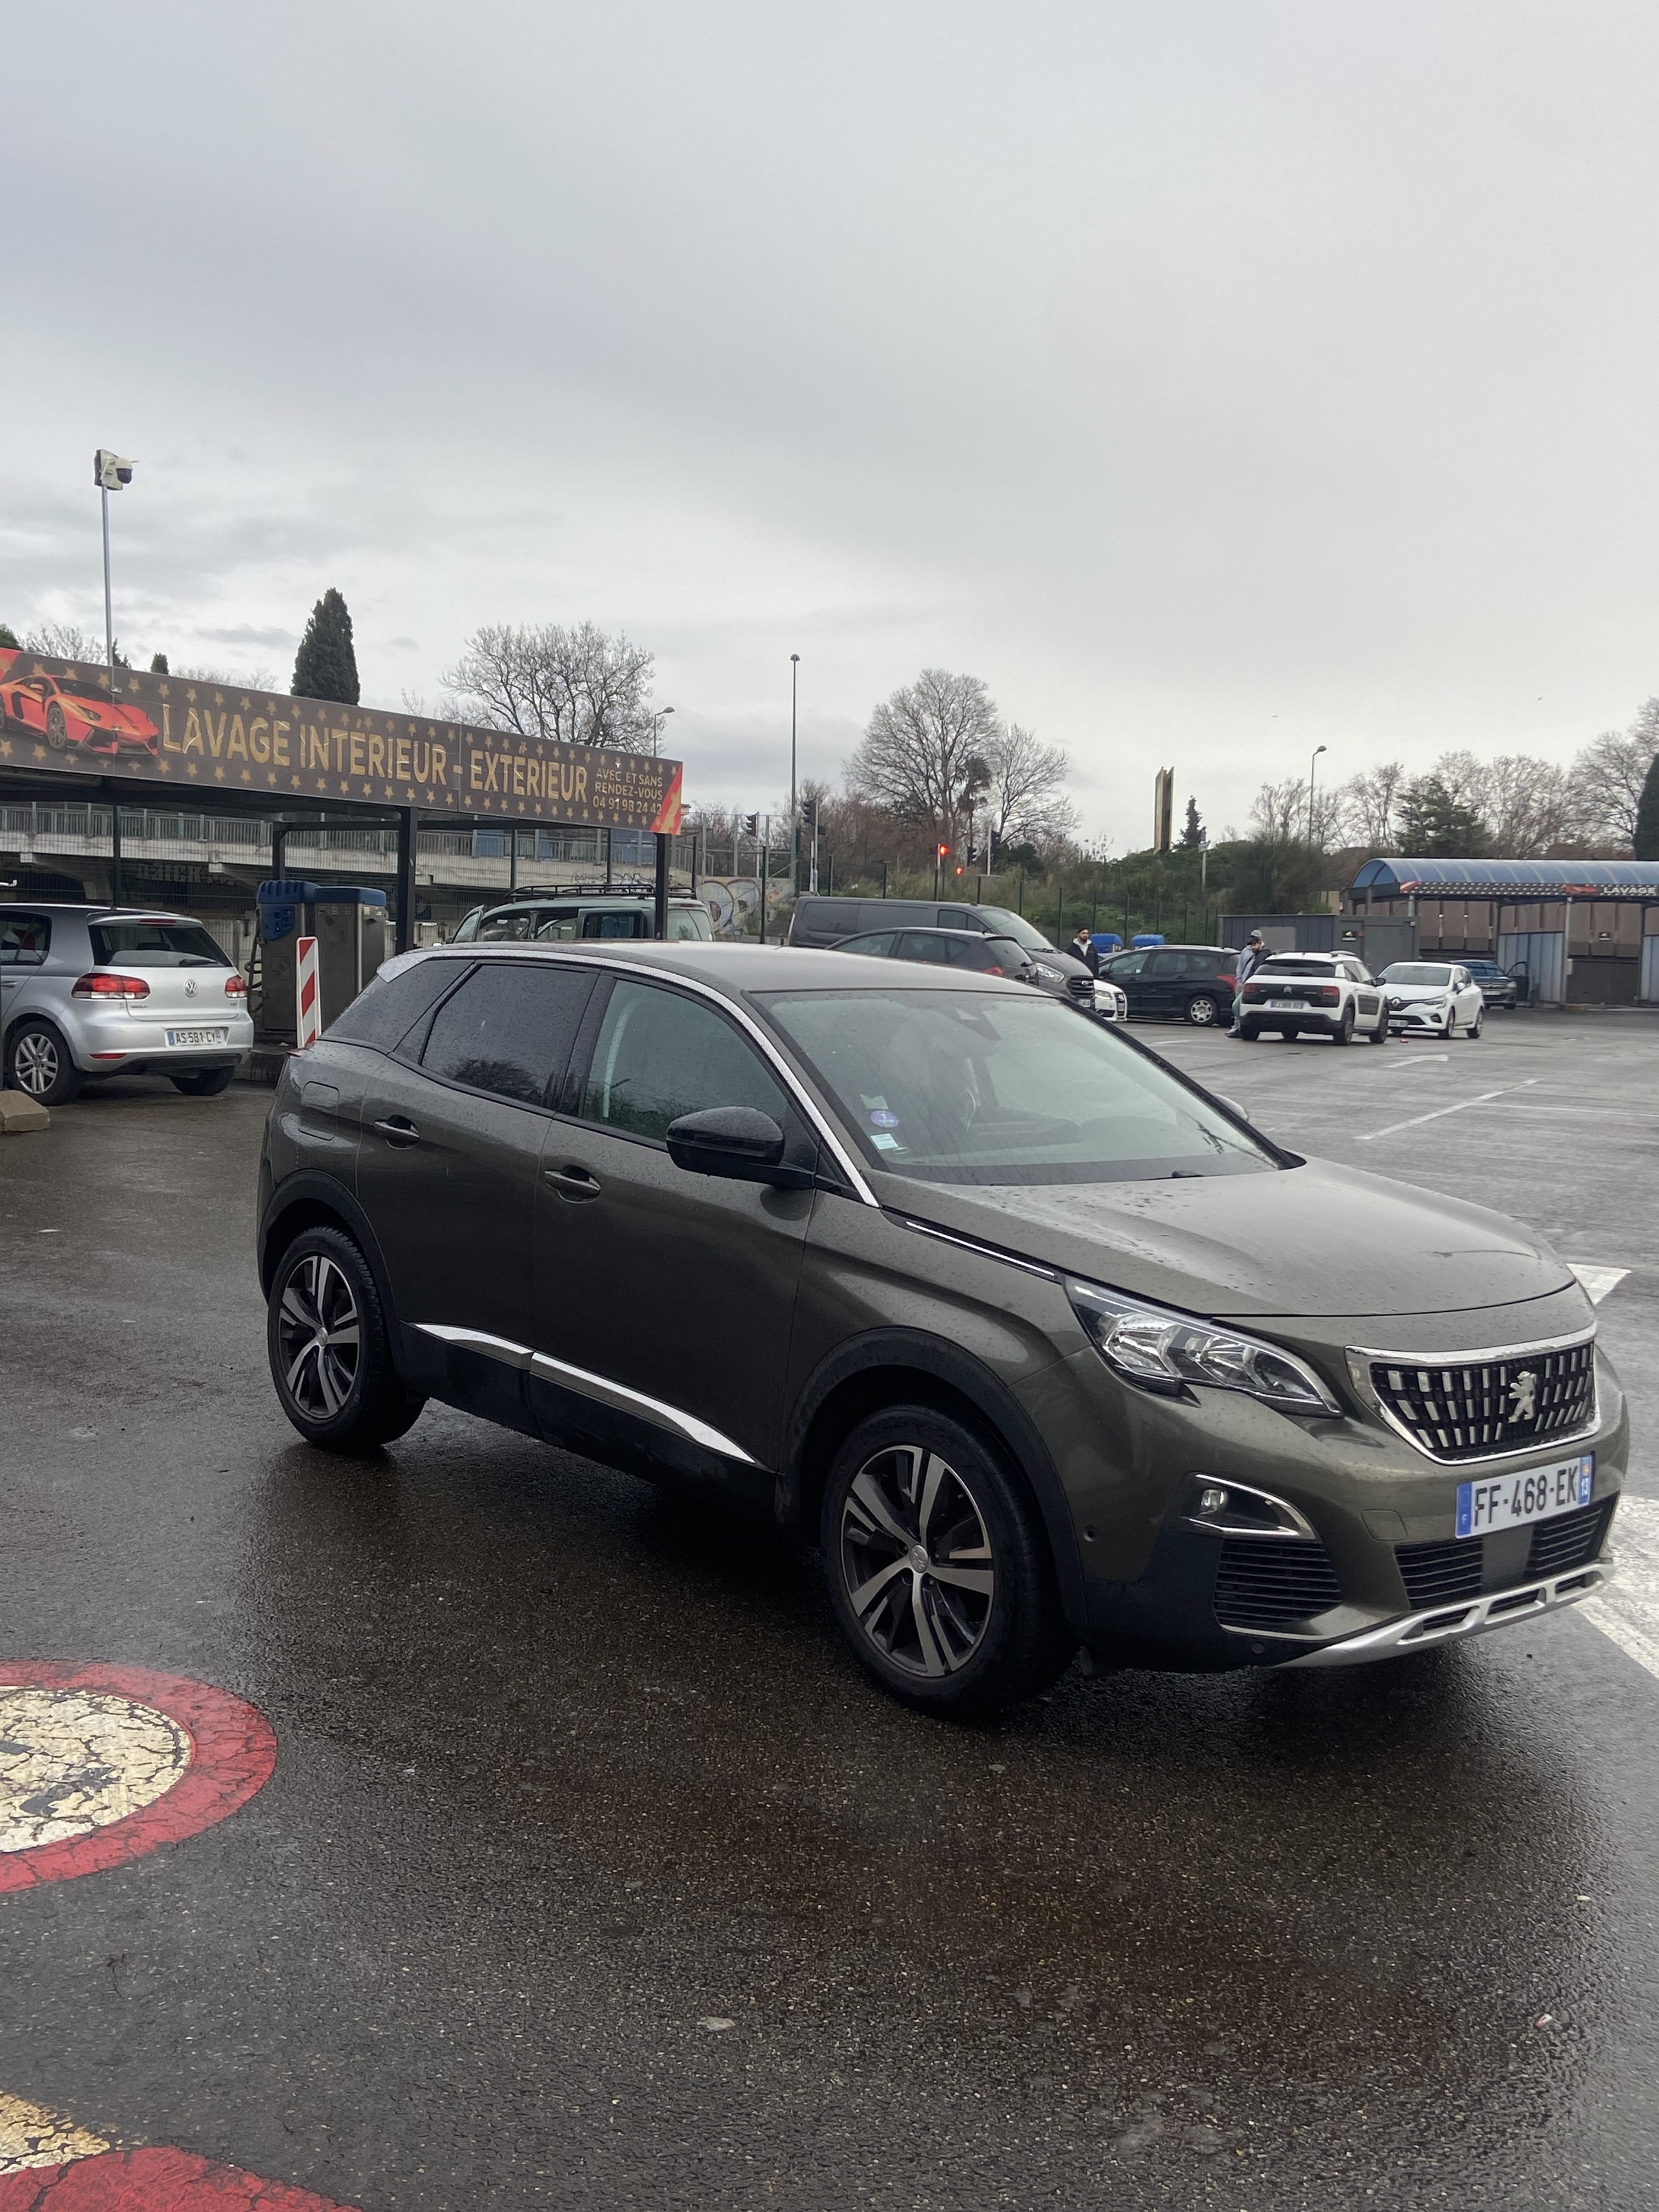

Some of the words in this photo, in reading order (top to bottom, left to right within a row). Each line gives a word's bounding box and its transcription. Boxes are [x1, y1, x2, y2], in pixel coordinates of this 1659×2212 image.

[162, 704, 290, 767] LAVAGE
[300, 719, 447, 786] INTÉRIEUR
[596, 768, 622, 782] AVEC
[626, 772, 637, 784] ET
[639, 774, 663, 787] SANS
[595, 781, 663, 801] RENDEZ-VOUS
[592, 795, 606, 809] 04
[608, 797, 620, 810] 91
[622, 799, 634, 812] 98
[636, 801, 648, 814] 24
[650, 803, 662, 815] 42
[1474, 1465, 1578, 1527] FF-468-EK
